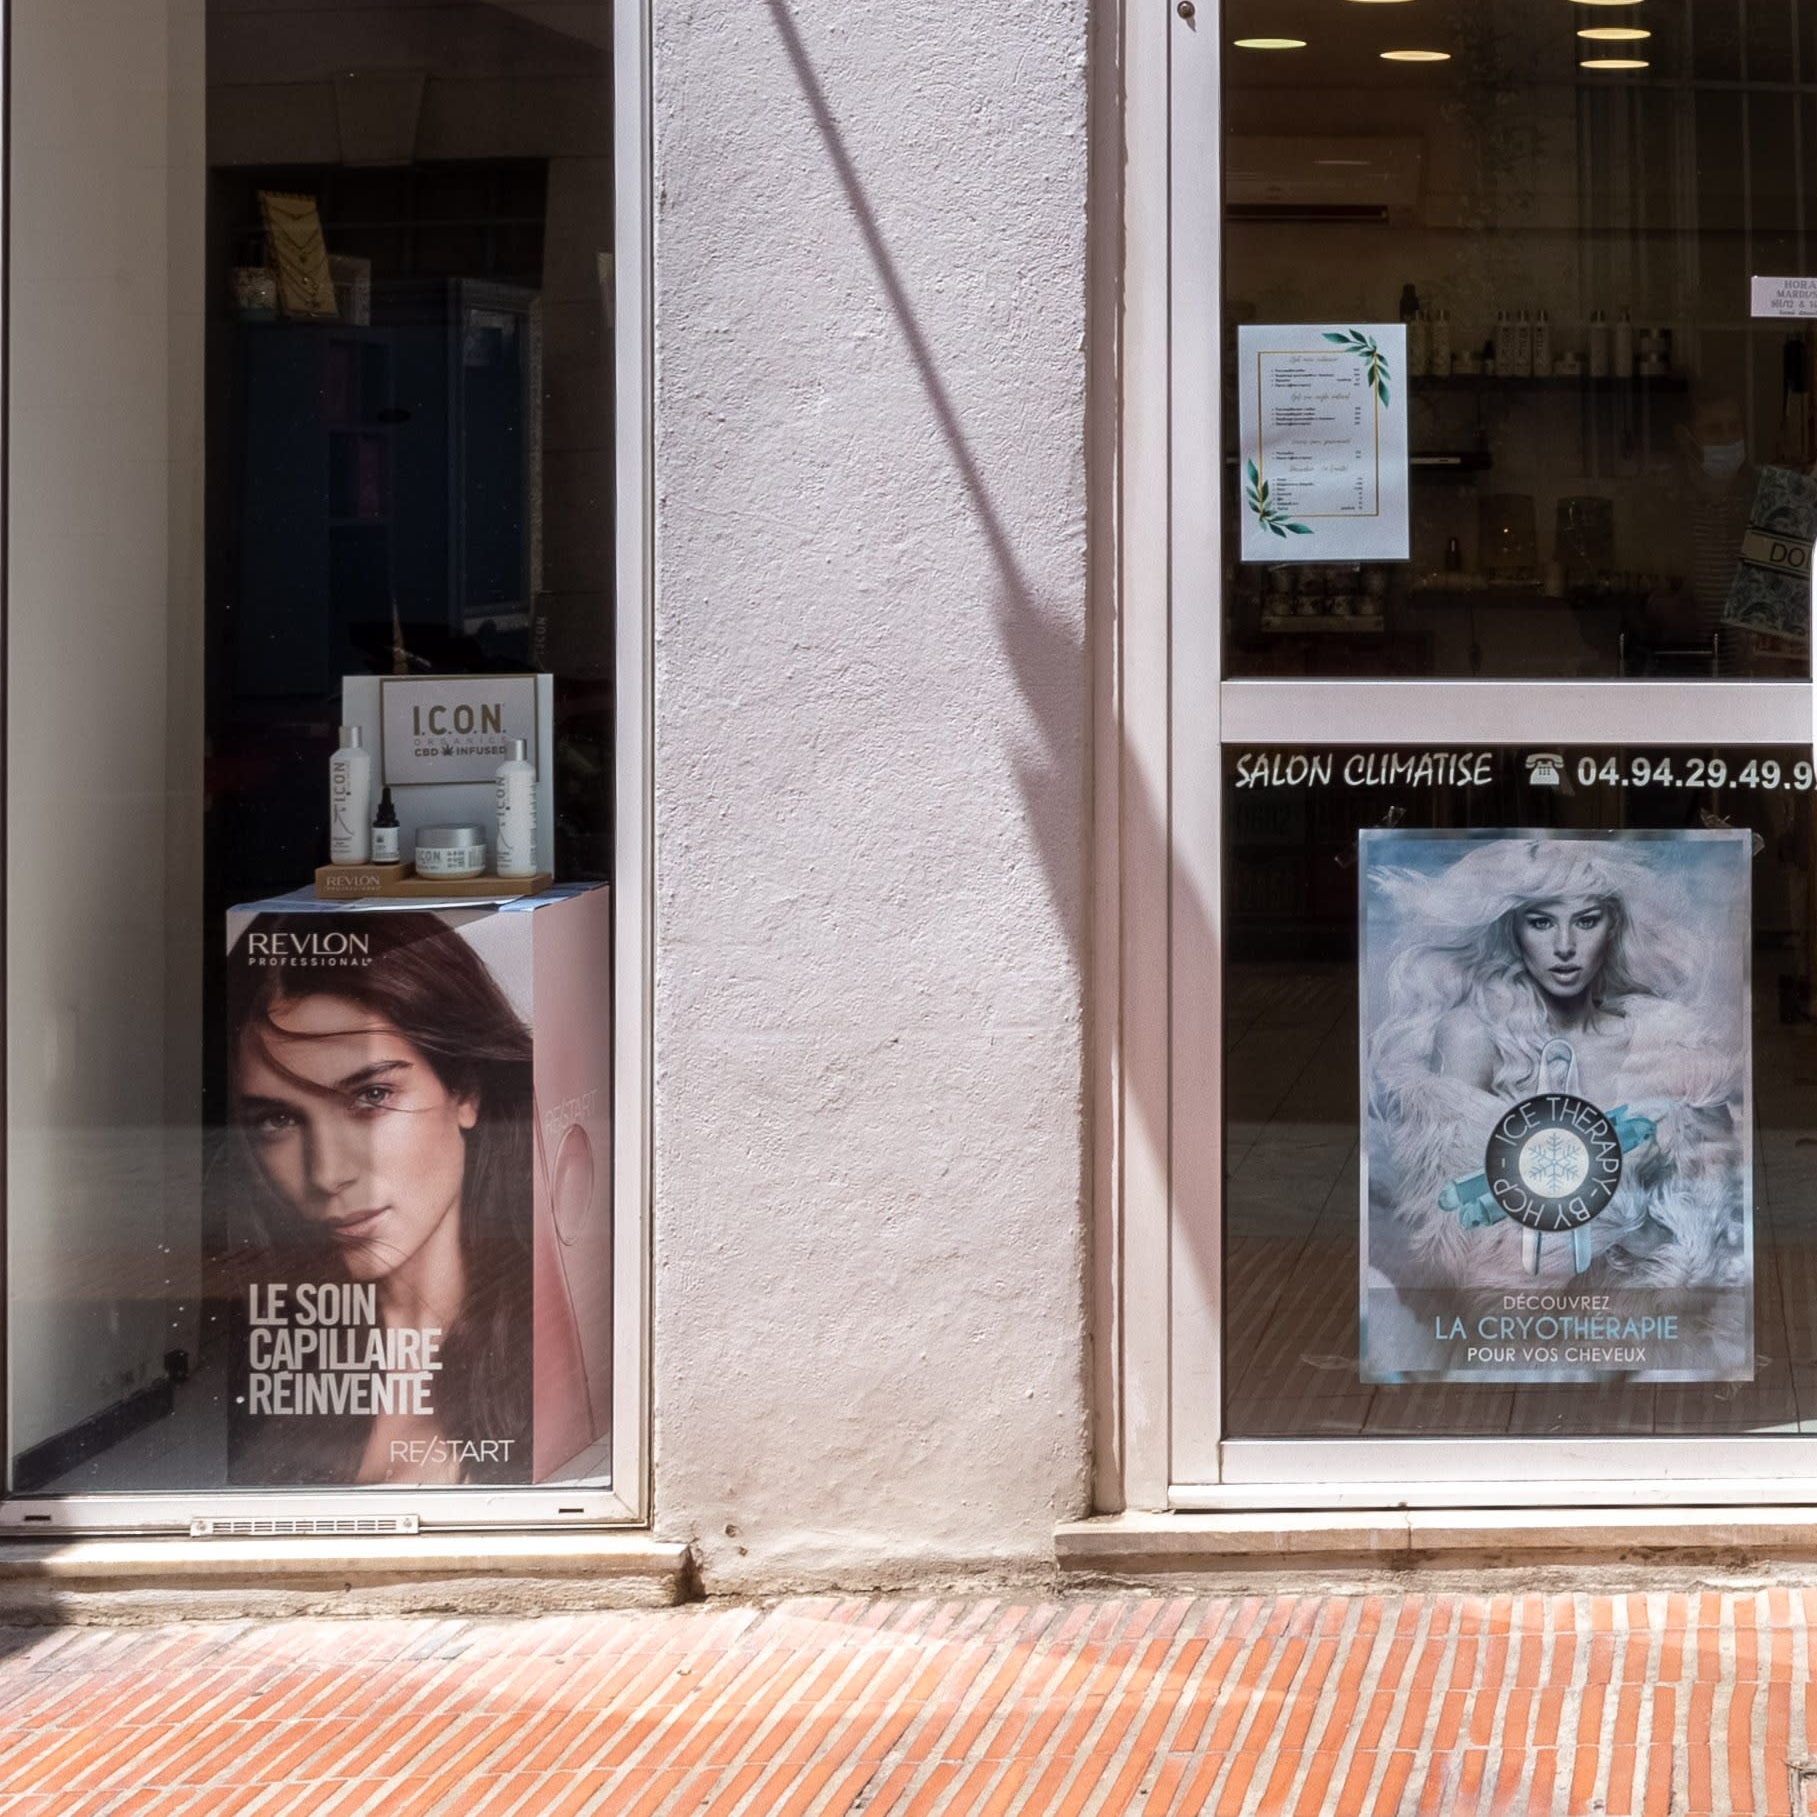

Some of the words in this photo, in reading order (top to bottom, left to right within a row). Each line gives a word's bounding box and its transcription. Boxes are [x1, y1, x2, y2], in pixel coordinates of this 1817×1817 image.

[415, 748, 439, 757] CBD
[456, 745, 507, 756] INFUSED
[1235, 752, 1333, 788] SALON
[1343, 752, 1493, 787] CLIMATISE
[326, 874, 381, 887] REVLON
[249, 932, 369, 955] REVLON
[1495, 1102, 1541, 1146] ICE
[1546, 1096, 1620, 1196] THERAPY
[1493, 1178, 1546, 1227] HCP
[1553, 1196, 1591, 1230] BY
[249, 1283, 289, 1326] LE
[295, 1283, 376, 1326] SOIN
[1503, 1293, 1610, 1310] DÉCOUVREZ
[1435, 1315, 1467, 1340] LA
[1478, 1312, 1679, 1340] CRYOTHÉRAPIE
[249, 1327, 443, 1371] CAPILLAIRE
[1467, 1347, 1516, 1362] POUR
[1523, 1347, 1559, 1362] VOS
[1565, 1347, 1646, 1362] CHEVEUX
